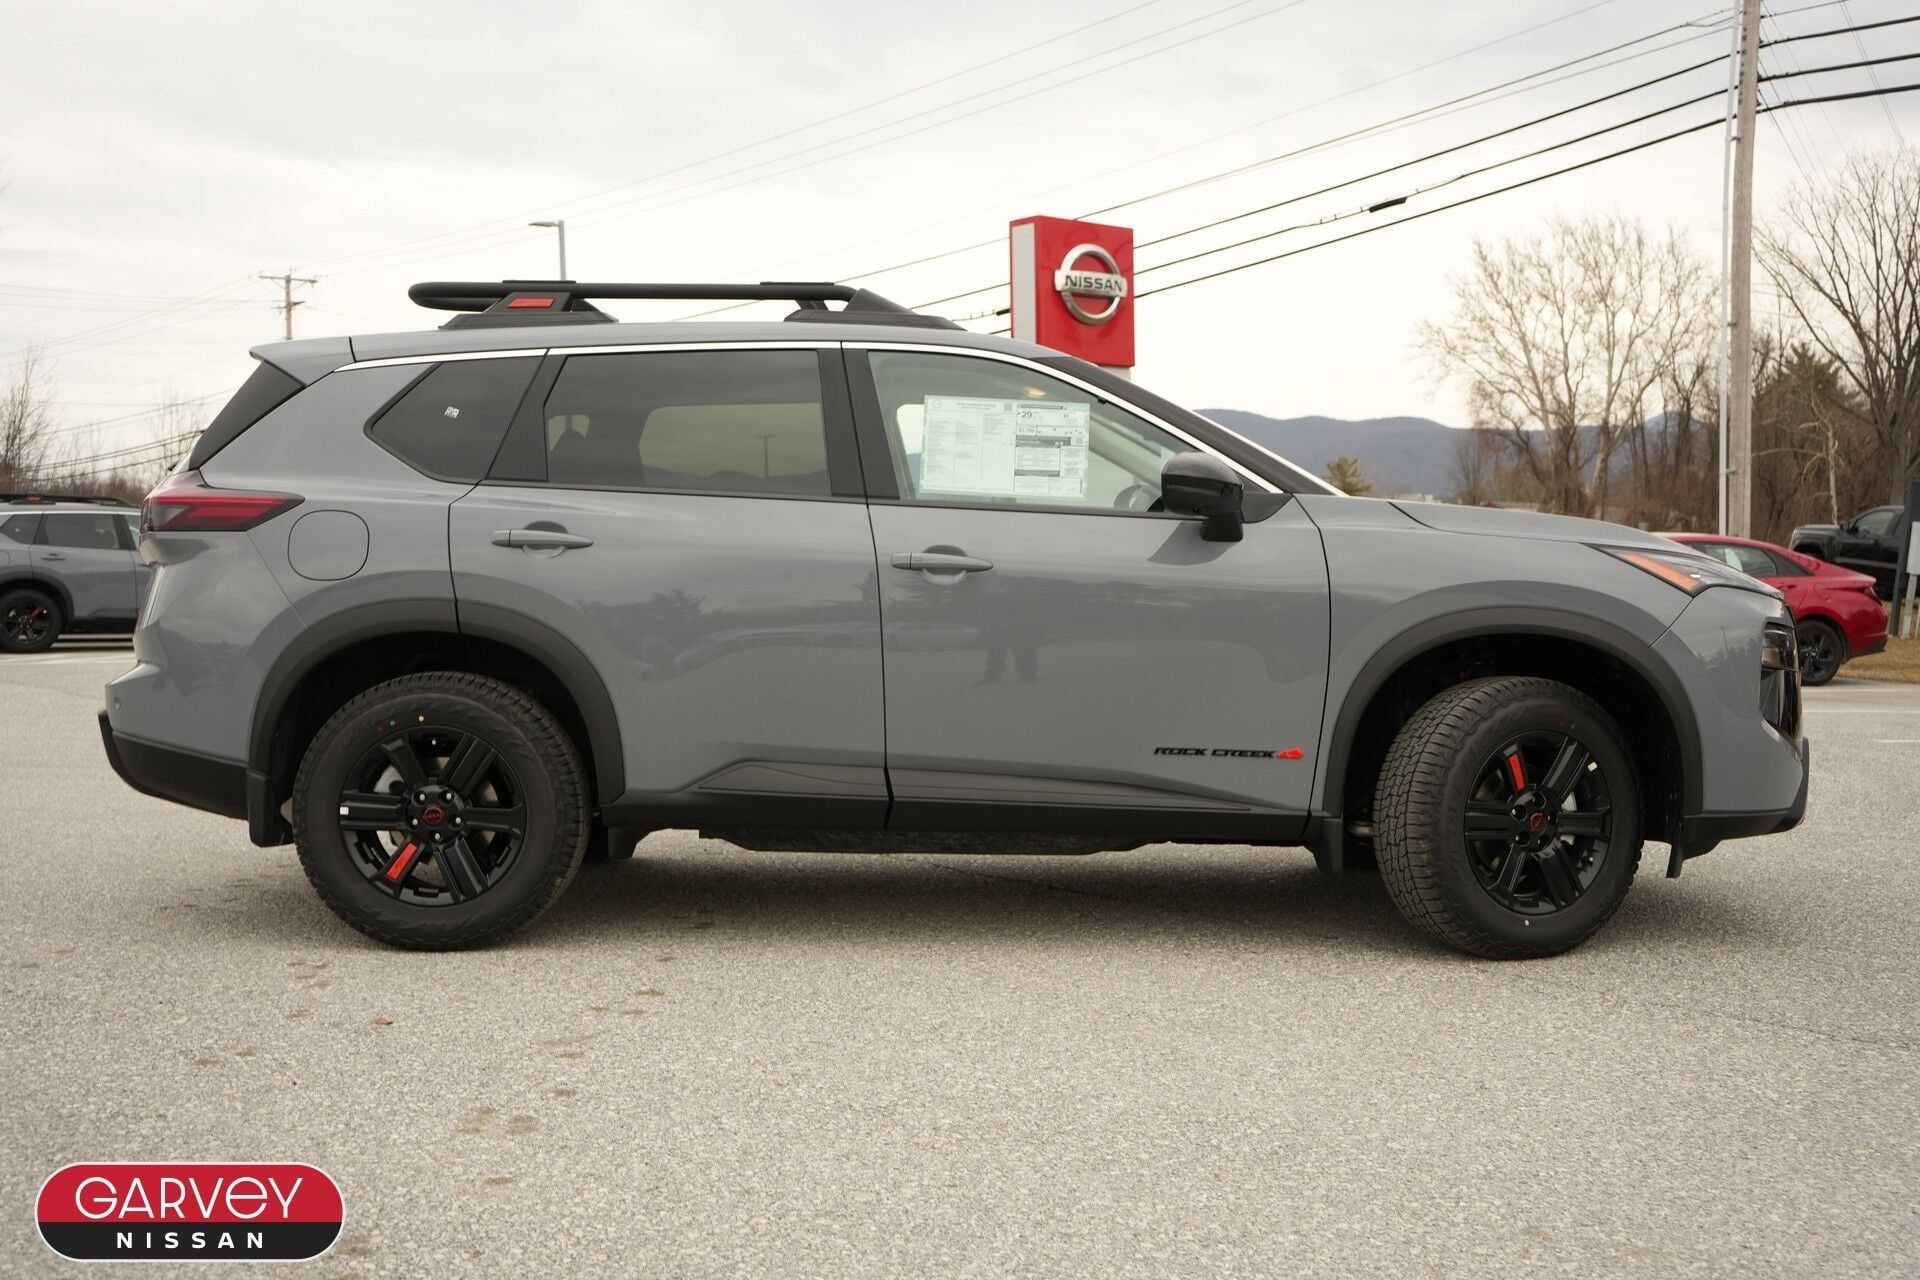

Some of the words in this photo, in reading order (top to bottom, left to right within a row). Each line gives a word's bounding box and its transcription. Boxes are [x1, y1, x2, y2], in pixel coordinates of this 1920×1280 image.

[1065, 275, 1122, 292] NISSAN
[1021, 410, 1033, 419] 29
[1153, 747, 1208, 756] ROCK
[1211, 748, 1275, 758] CREEK
